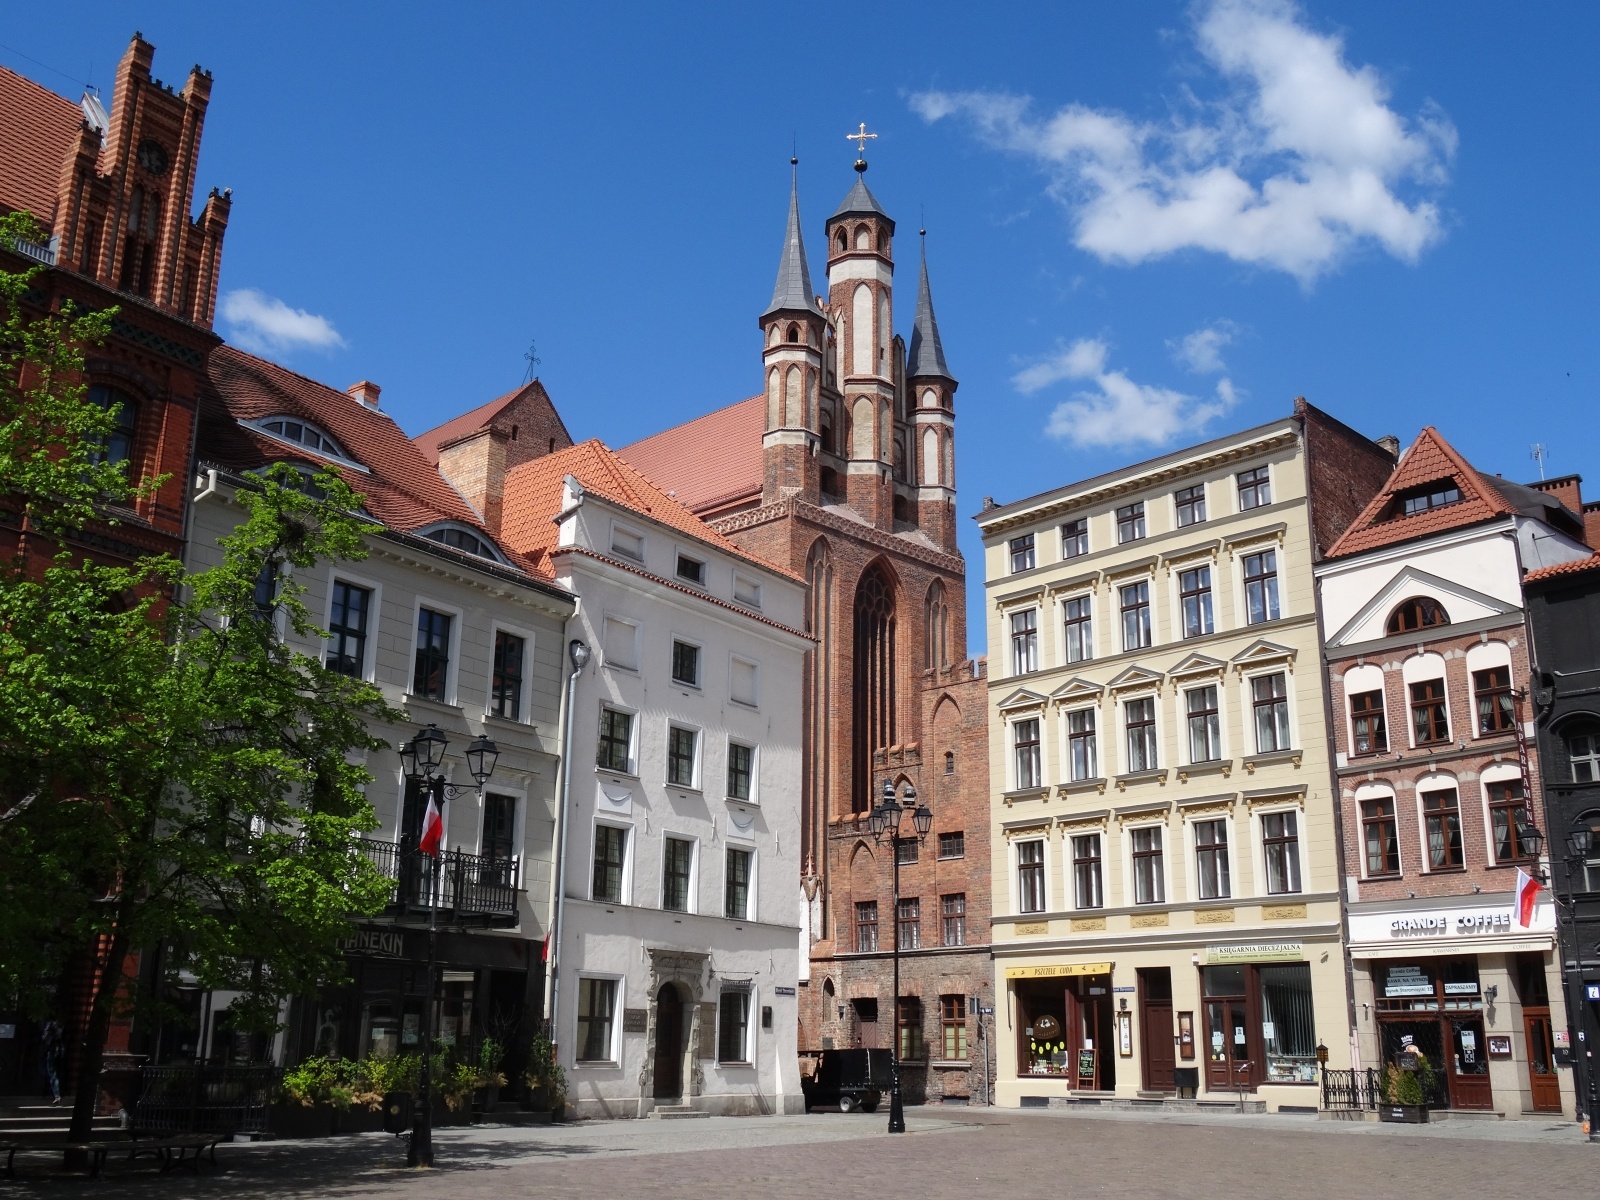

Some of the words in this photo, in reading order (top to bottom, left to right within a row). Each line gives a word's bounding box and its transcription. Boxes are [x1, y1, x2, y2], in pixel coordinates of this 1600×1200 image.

[1517, 721, 1533, 826] APARTAMEN
[1390, 917, 1447, 931] GRANDE
[1456, 913, 1511, 928] COFFEE
[1059, 966, 1073, 975] CUDA
